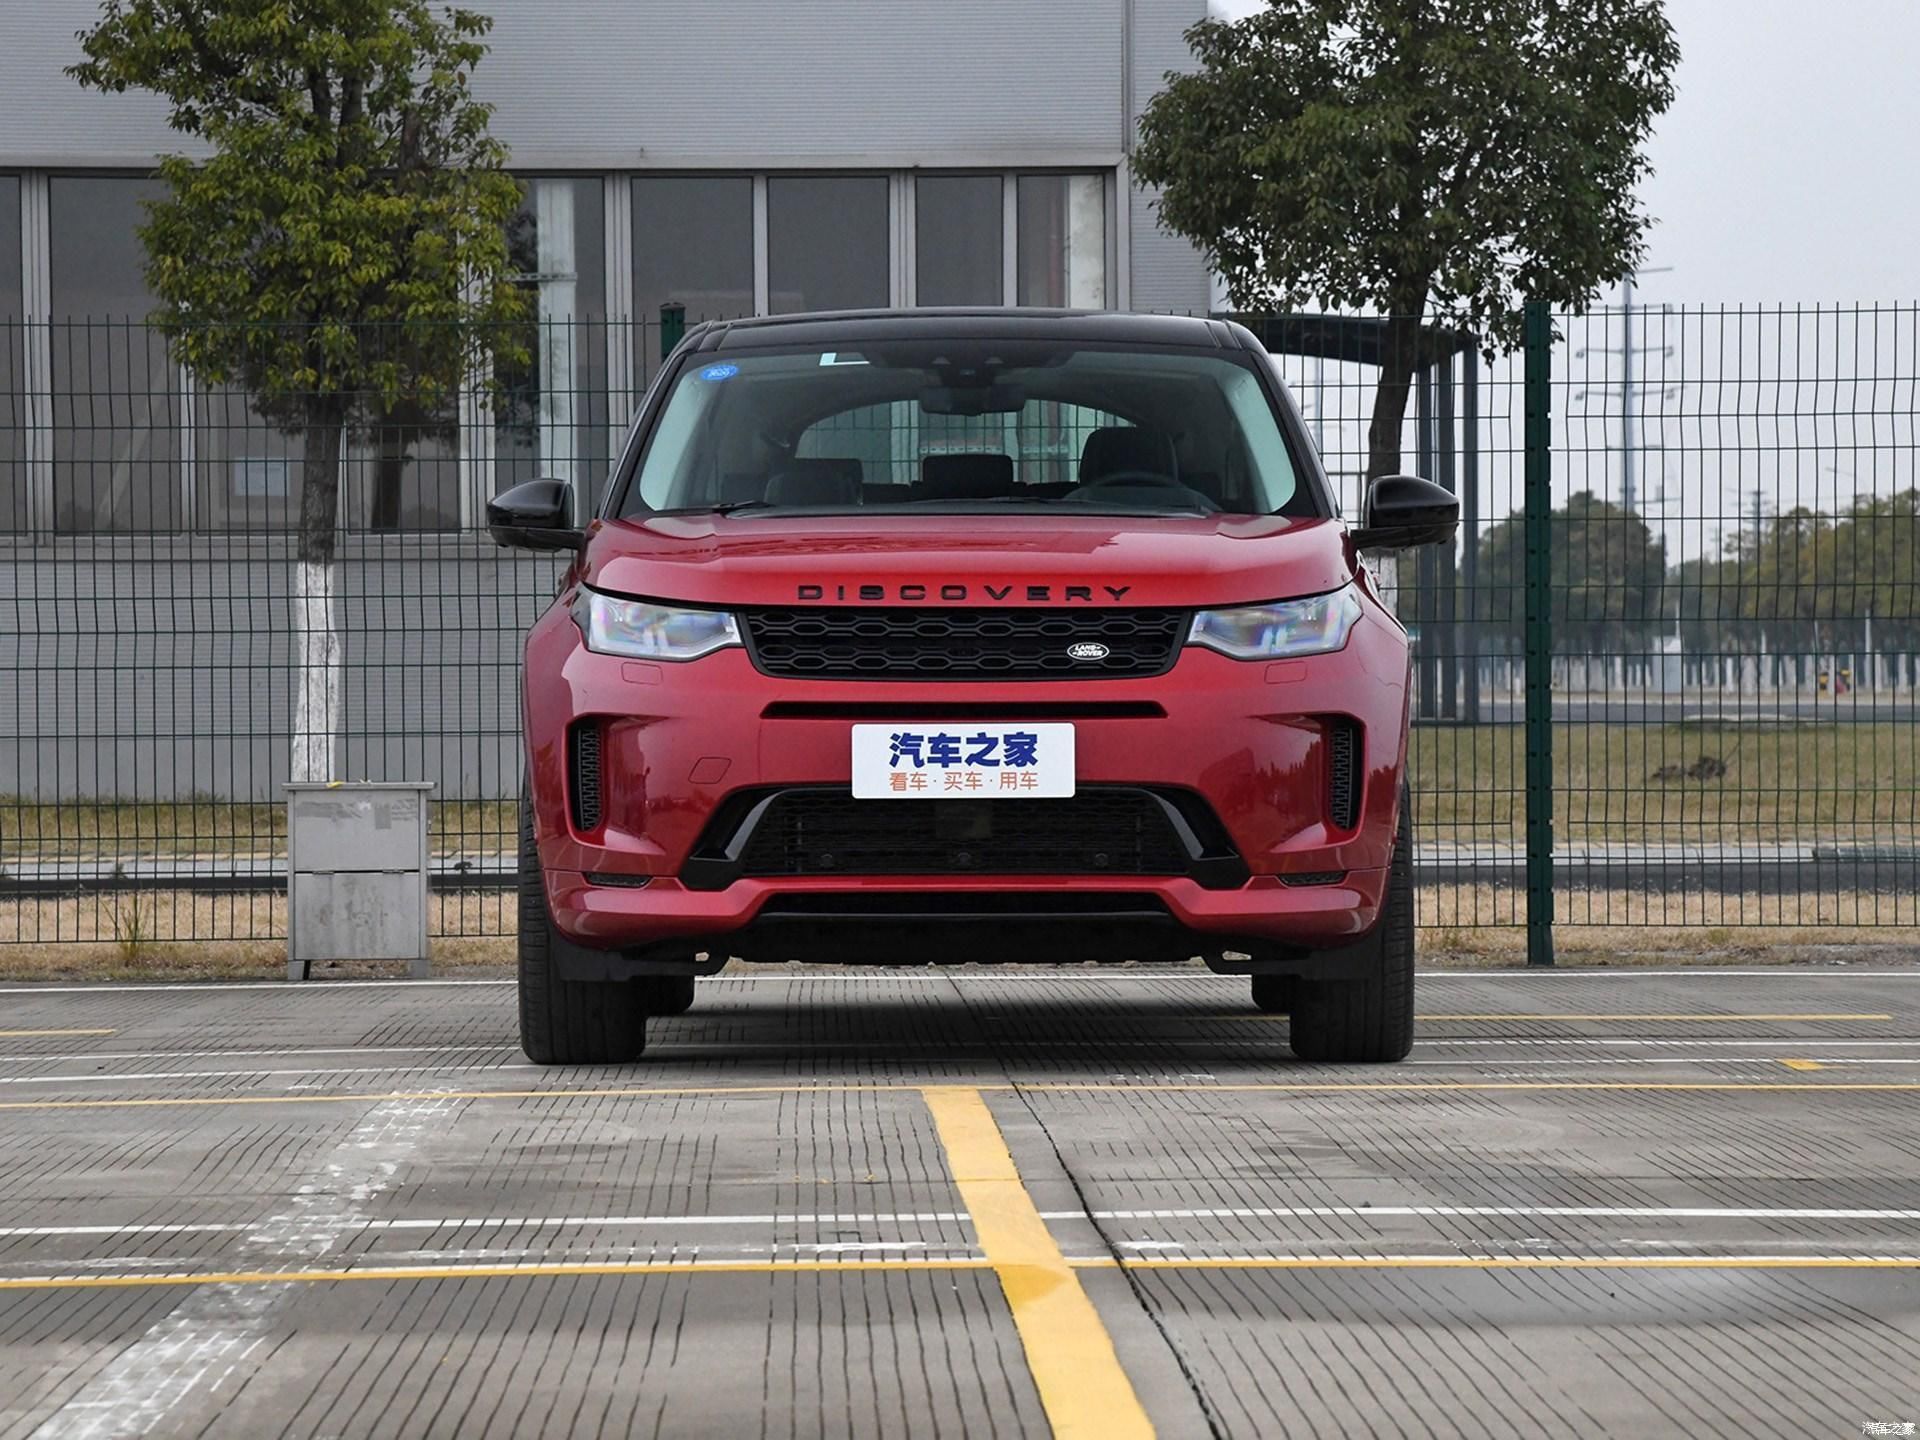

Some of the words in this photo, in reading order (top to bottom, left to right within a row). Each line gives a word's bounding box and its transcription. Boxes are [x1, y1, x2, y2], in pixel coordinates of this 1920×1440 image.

[797, 585, 1132, 601] DISCOVERY
[889, 731, 1039, 768] 汽车之家
